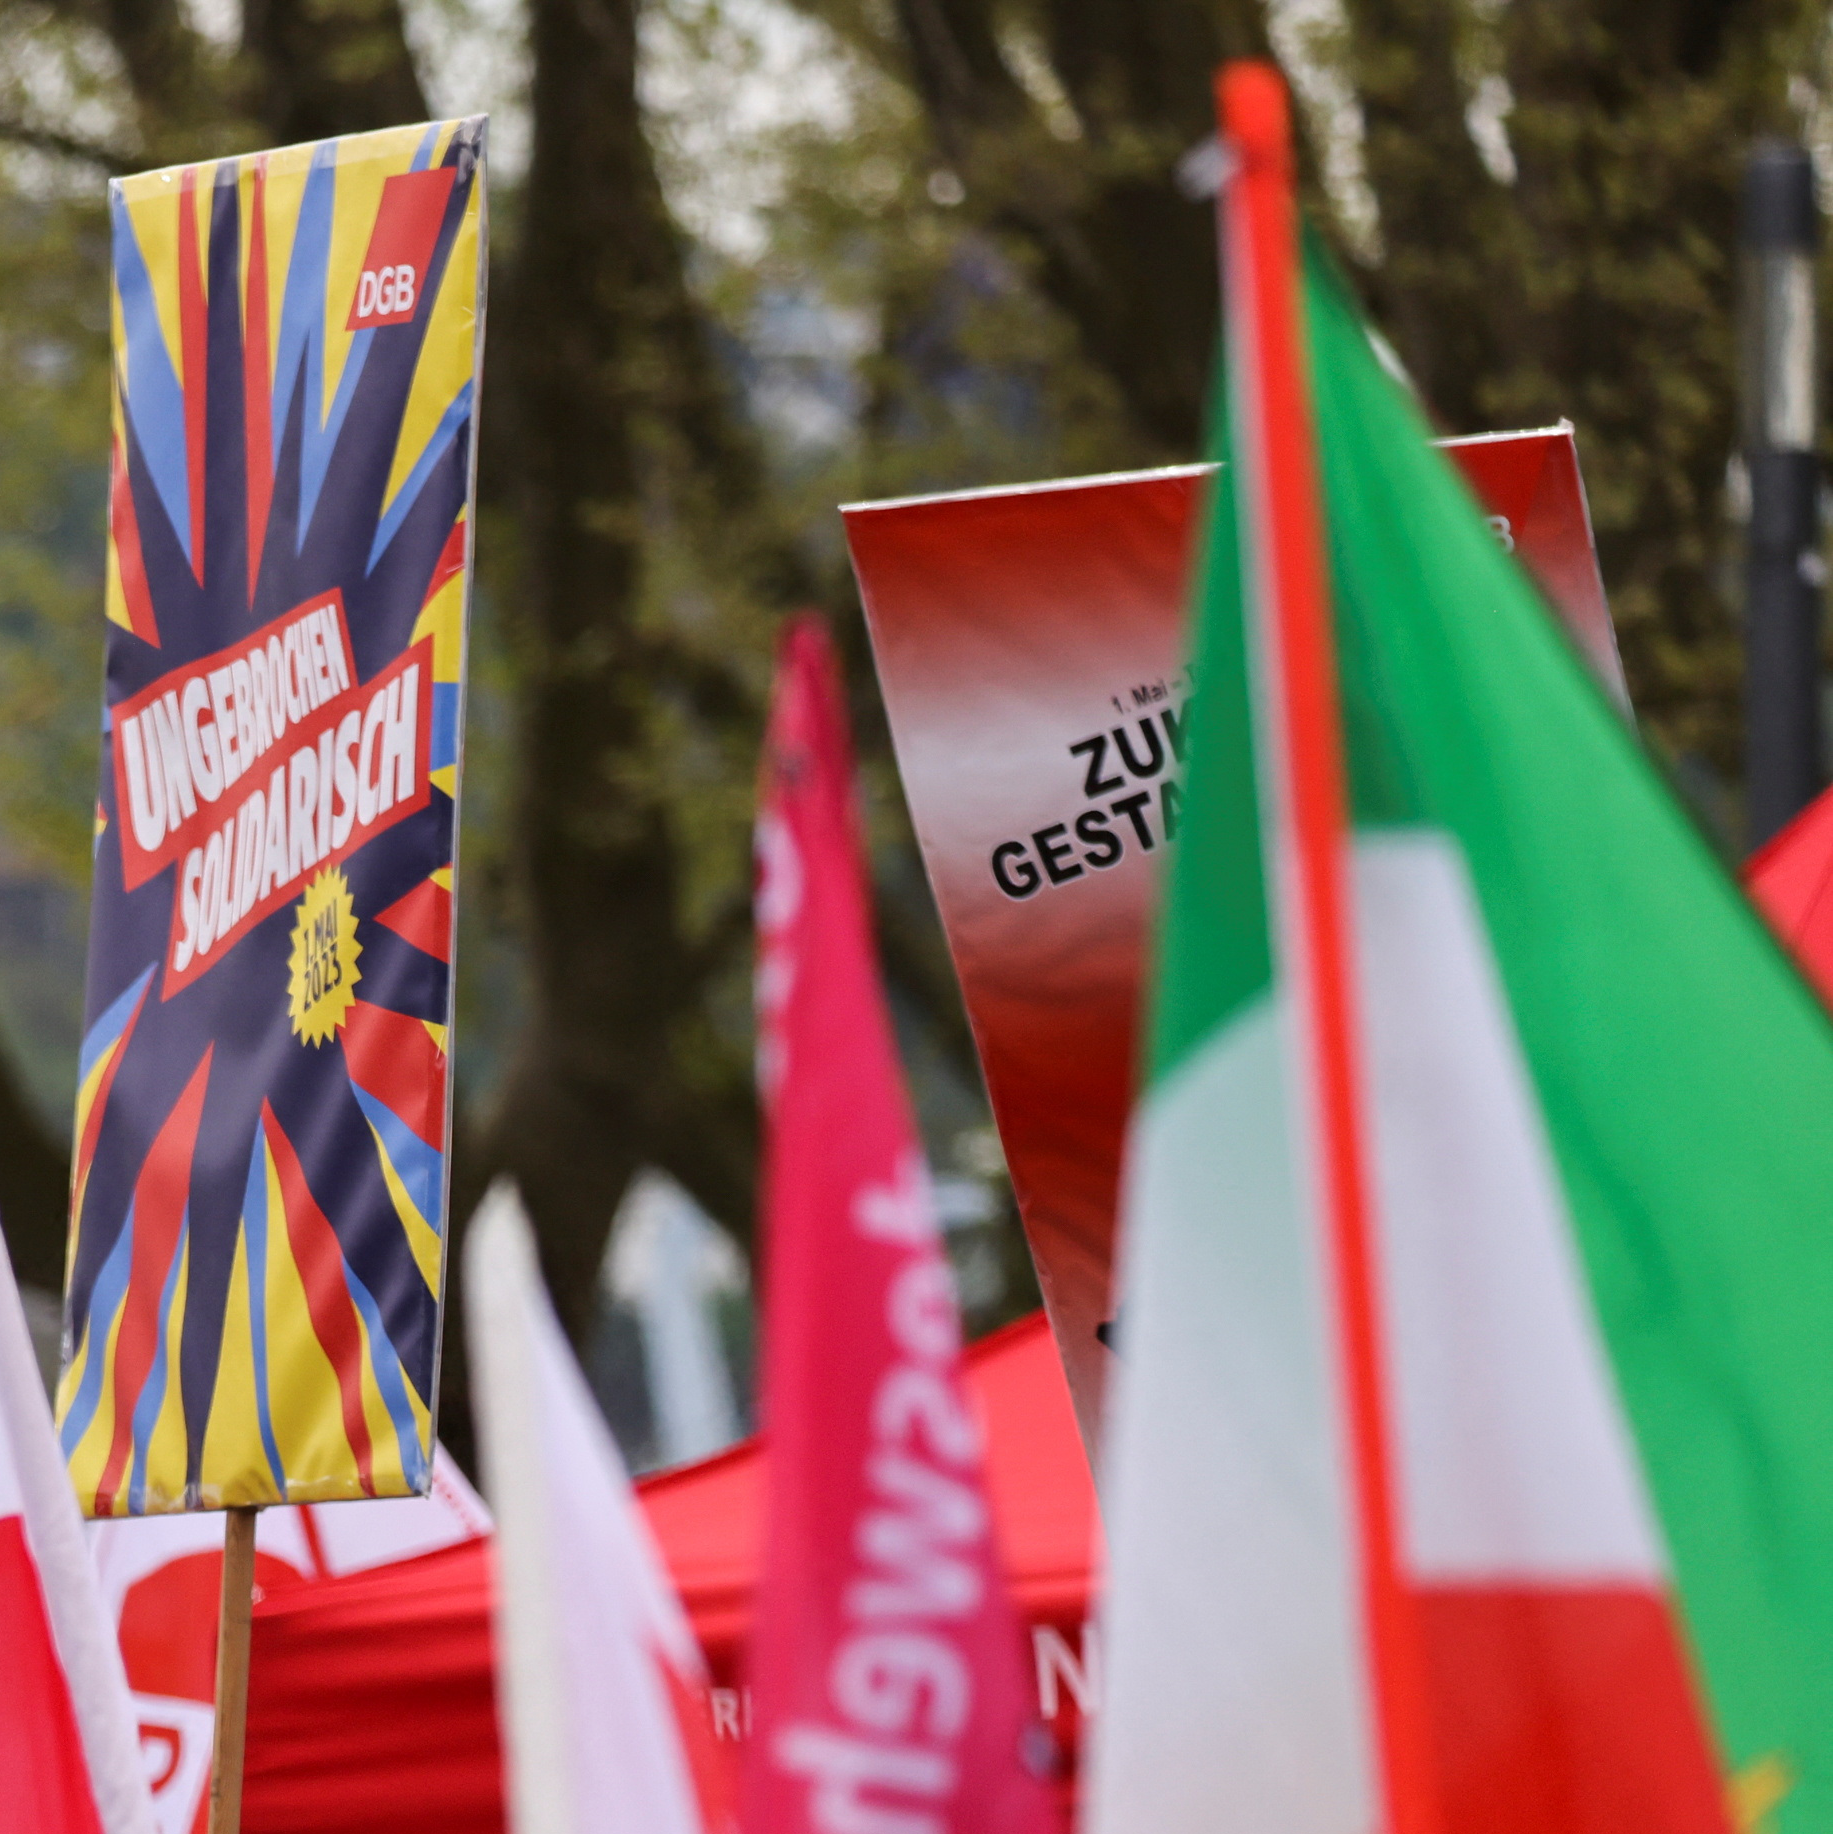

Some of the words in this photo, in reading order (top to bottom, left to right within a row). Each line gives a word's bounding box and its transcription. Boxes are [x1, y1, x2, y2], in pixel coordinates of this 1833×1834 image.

[357, 264, 415, 319] DGB
[1131, 679, 1169, 705] Mai
[120, 603, 349, 852] UNGEBROCHEN
[173, 664, 419, 972] SOLIDARISCH
[314, 897, 337, 953] MAI
[304, 941, 342, 1013] 2023
